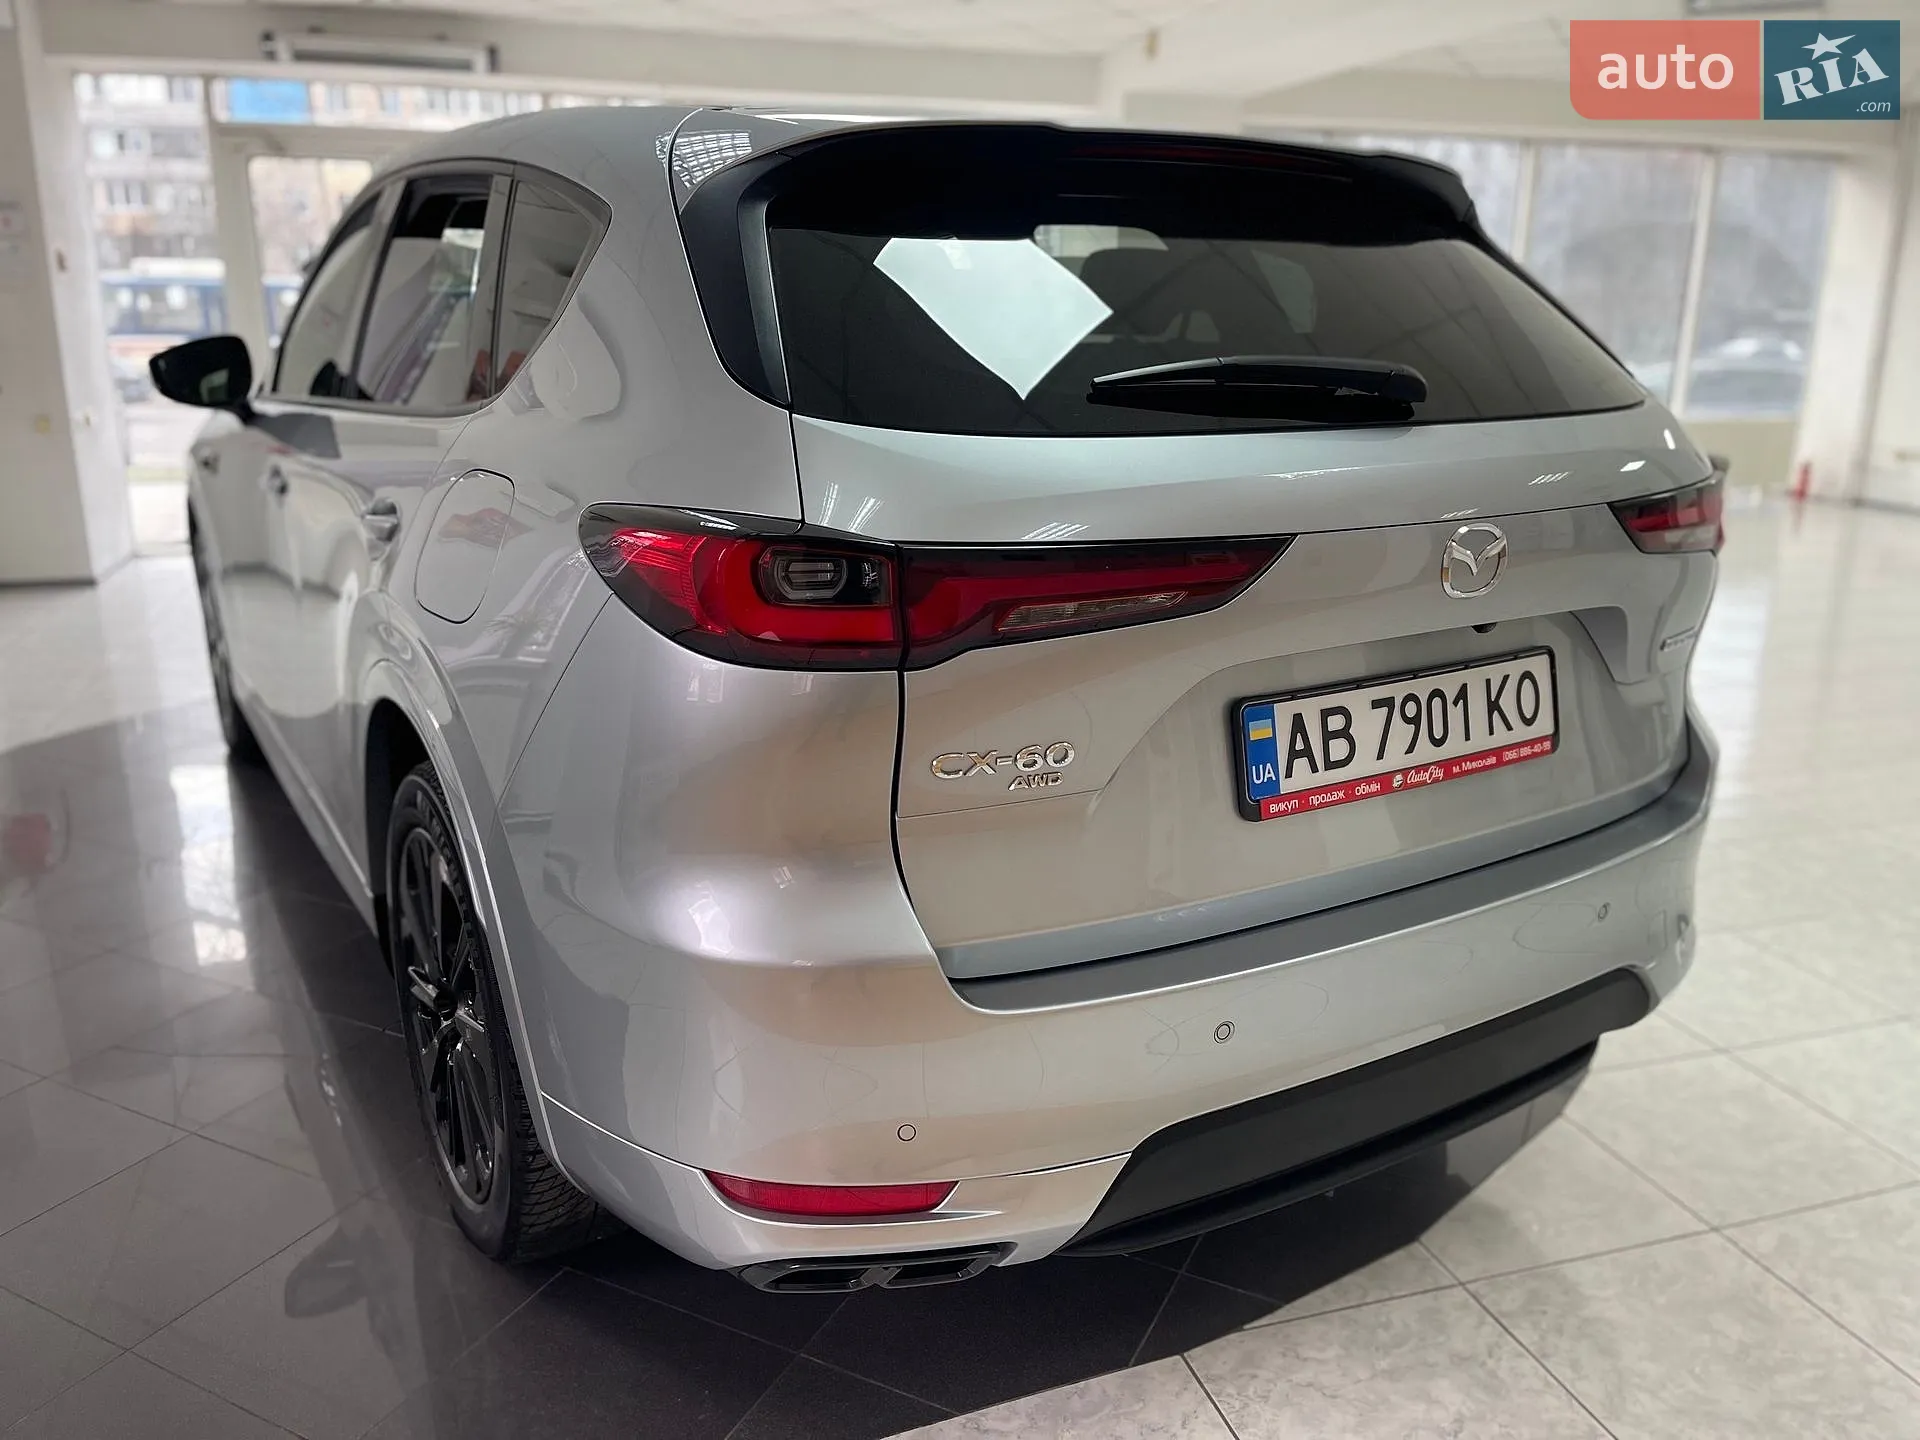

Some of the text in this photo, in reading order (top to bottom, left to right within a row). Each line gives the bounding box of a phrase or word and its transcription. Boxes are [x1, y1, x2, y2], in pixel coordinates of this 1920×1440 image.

[1284, 670, 1541, 780] AB 7901 KO
[931, 740, 1076, 779] CX-60
[1252, 762, 1276, 784] UA
[1007, 771, 1065, 791] AWD
[1407, 765, 1444, 784] AutoCity
[1269, 780, 1381, 814] викуп продаж обмін
